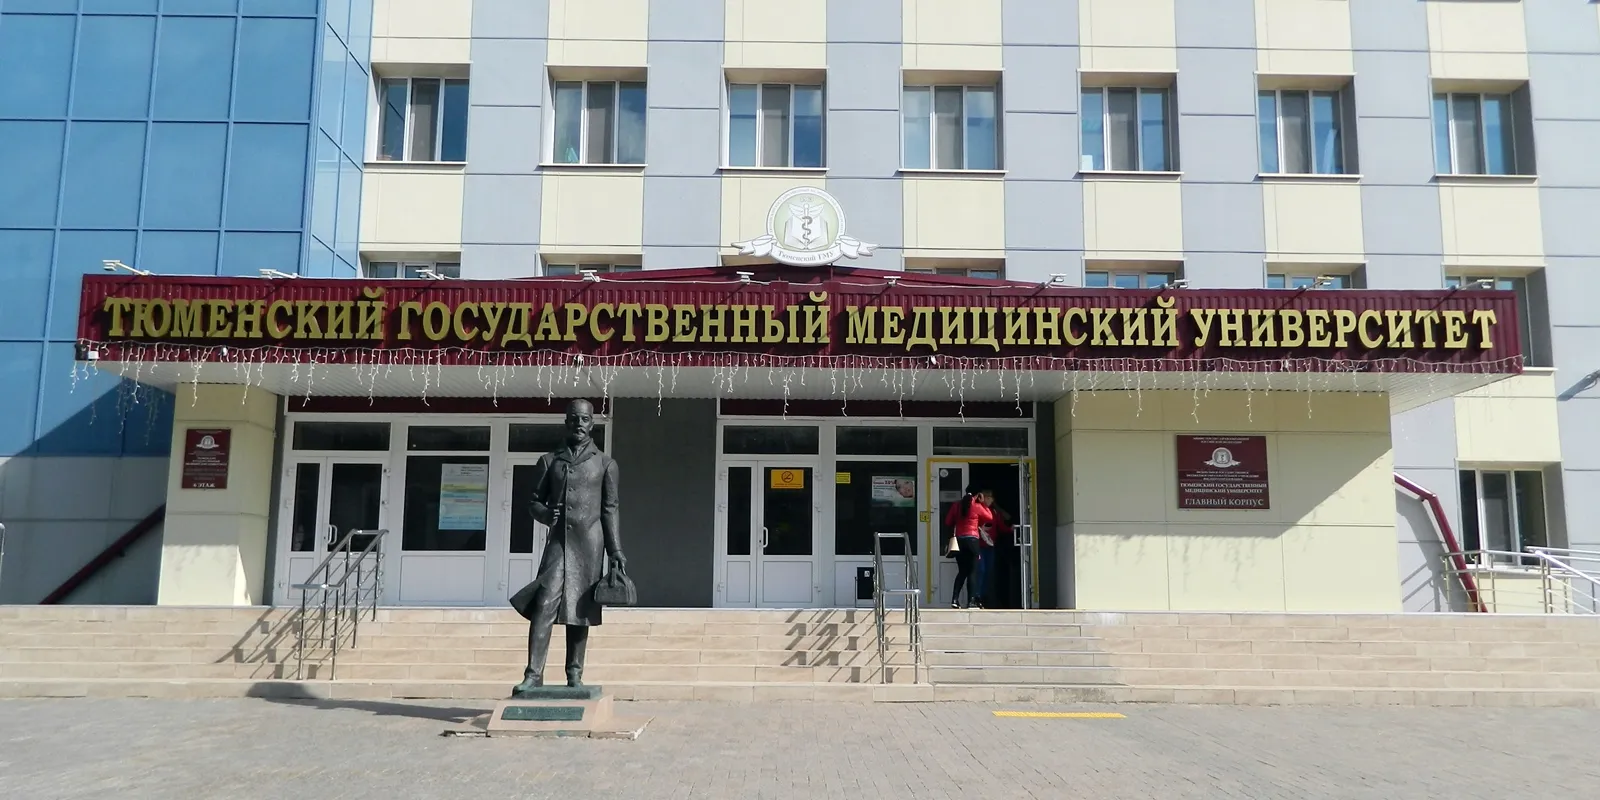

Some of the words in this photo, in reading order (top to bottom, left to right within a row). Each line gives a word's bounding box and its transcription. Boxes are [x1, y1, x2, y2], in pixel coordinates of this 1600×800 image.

[778, 251, 816, 261] Тюменский
[817, 251, 834, 261] ГМУ
[103, 286, 386, 340] ТЮМЕНСКИЙ
[397, 290, 831, 348] ГОСУДАРСТВЕННЫЙ
[845, 295, 1180, 352] МЕДИЦИНСКИЙ
[1189, 308, 1498, 349] УНИВЕРСИТЕТ
[1185, 497, 1227, 505] ГЛАВНЫЙ
[1229, 498, 1264, 506] КОРПУС
